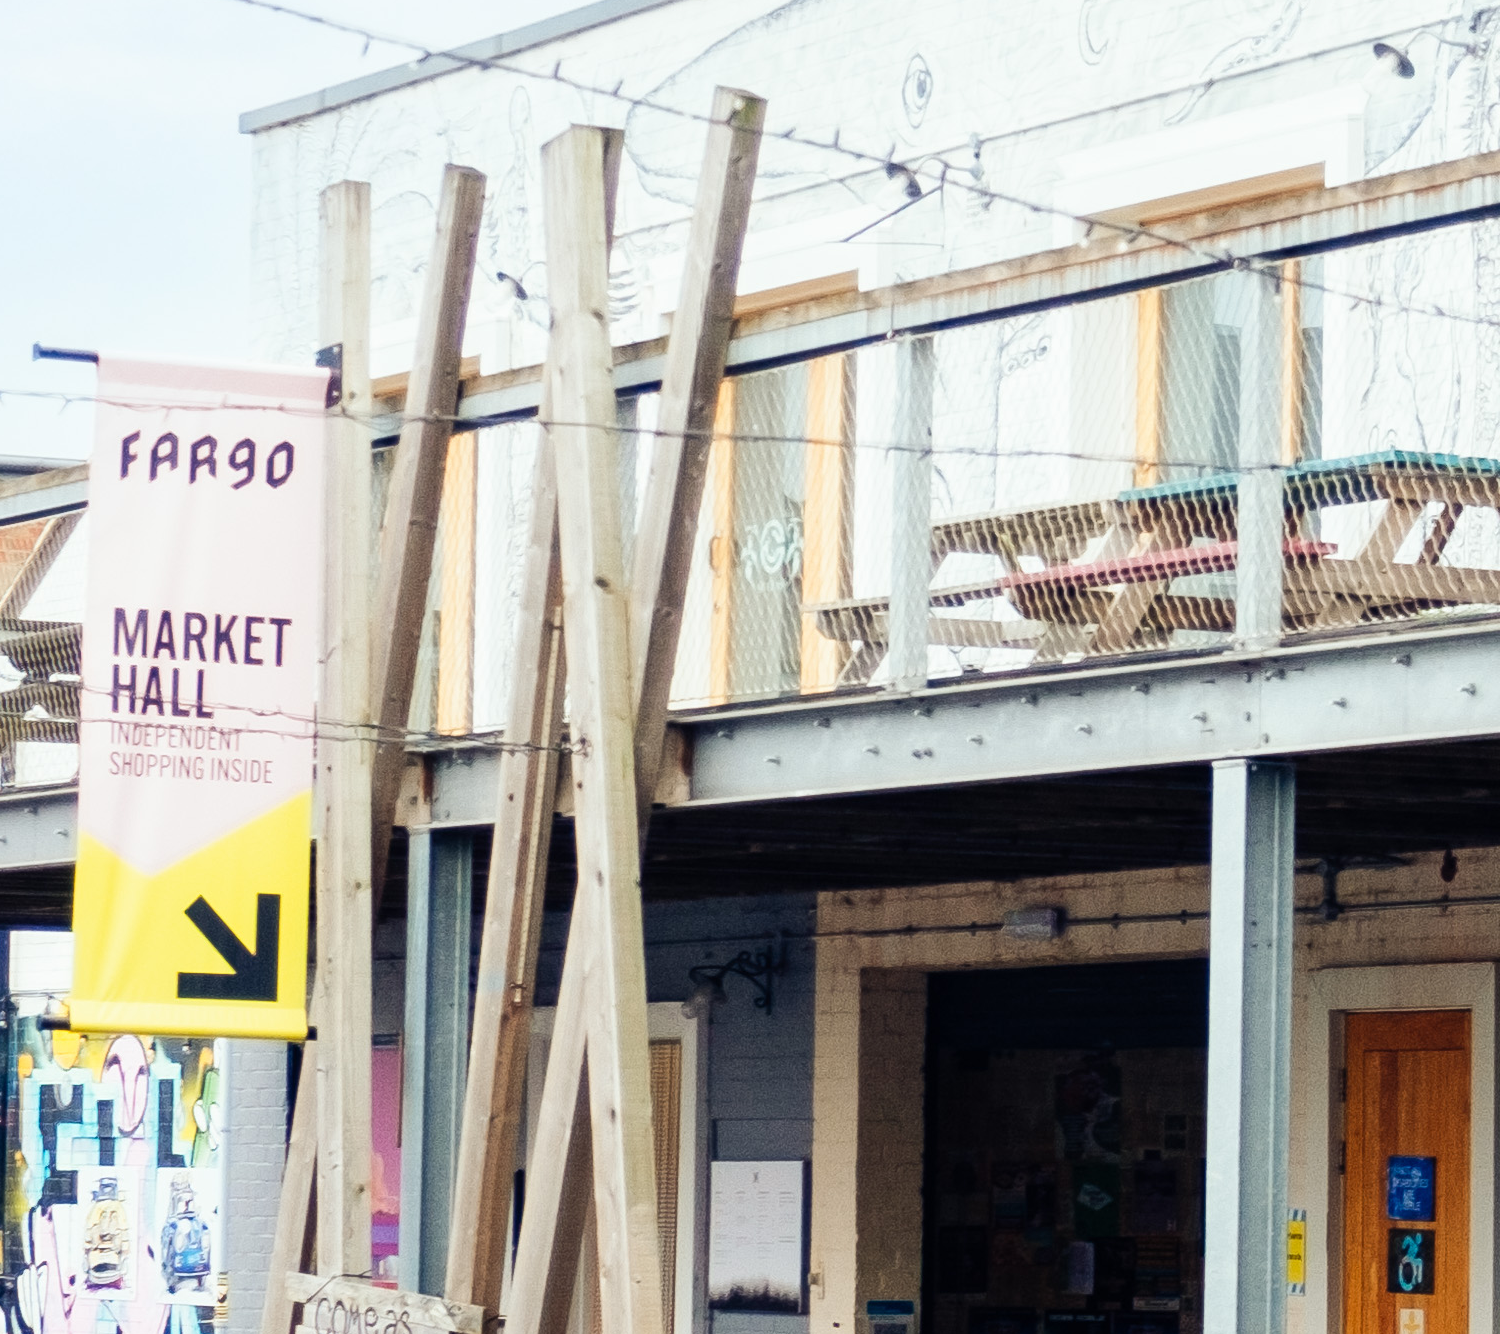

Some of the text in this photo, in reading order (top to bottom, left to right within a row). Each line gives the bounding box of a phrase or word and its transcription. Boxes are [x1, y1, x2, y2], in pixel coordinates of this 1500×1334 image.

[112, 607, 294, 667] MARKET
[110, 665, 215, 720] HALL
[109, 722, 243, 753] INDEPENDENT
[108, 752, 274, 785] SHOPPING INSIDE
